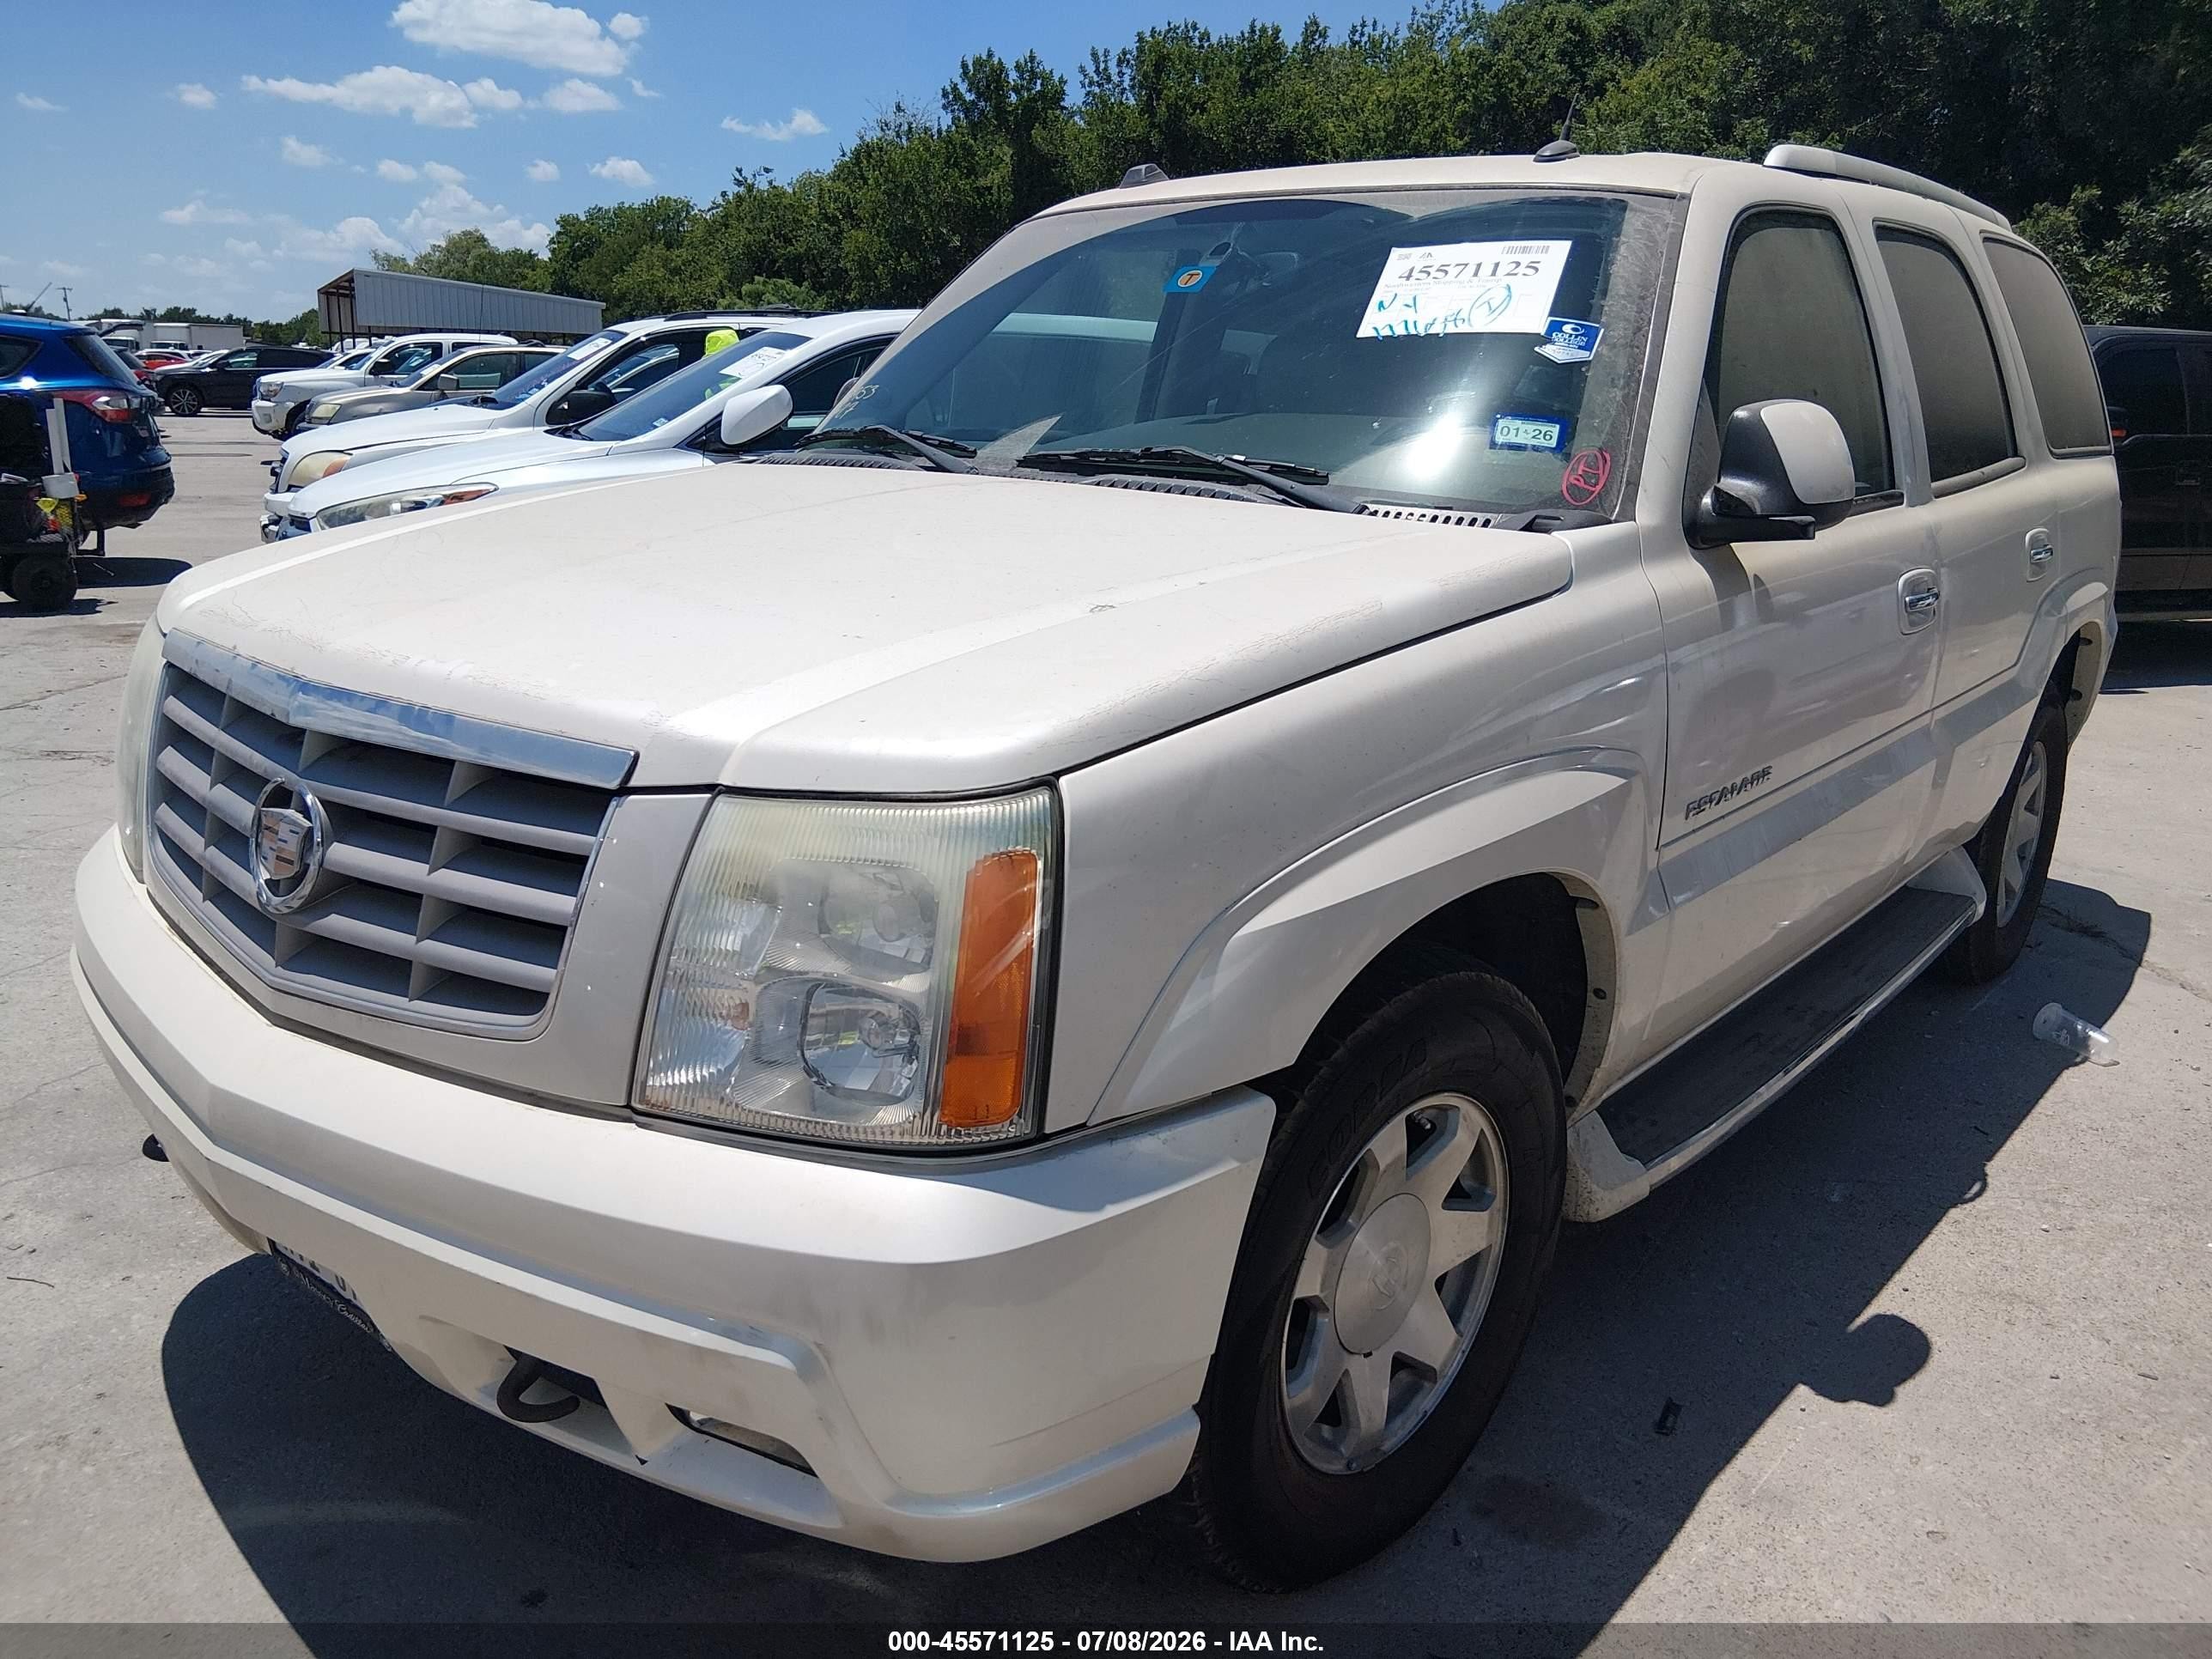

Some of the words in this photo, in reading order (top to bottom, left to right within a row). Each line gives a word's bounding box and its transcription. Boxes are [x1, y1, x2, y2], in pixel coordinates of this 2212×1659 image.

[1398, 260, 1542, 282] 45571125
[1184, 273, 1200, 286] T
[1552, 331, 1589, 343] COLLIN
[1531, 428, 1554, 441] 26
